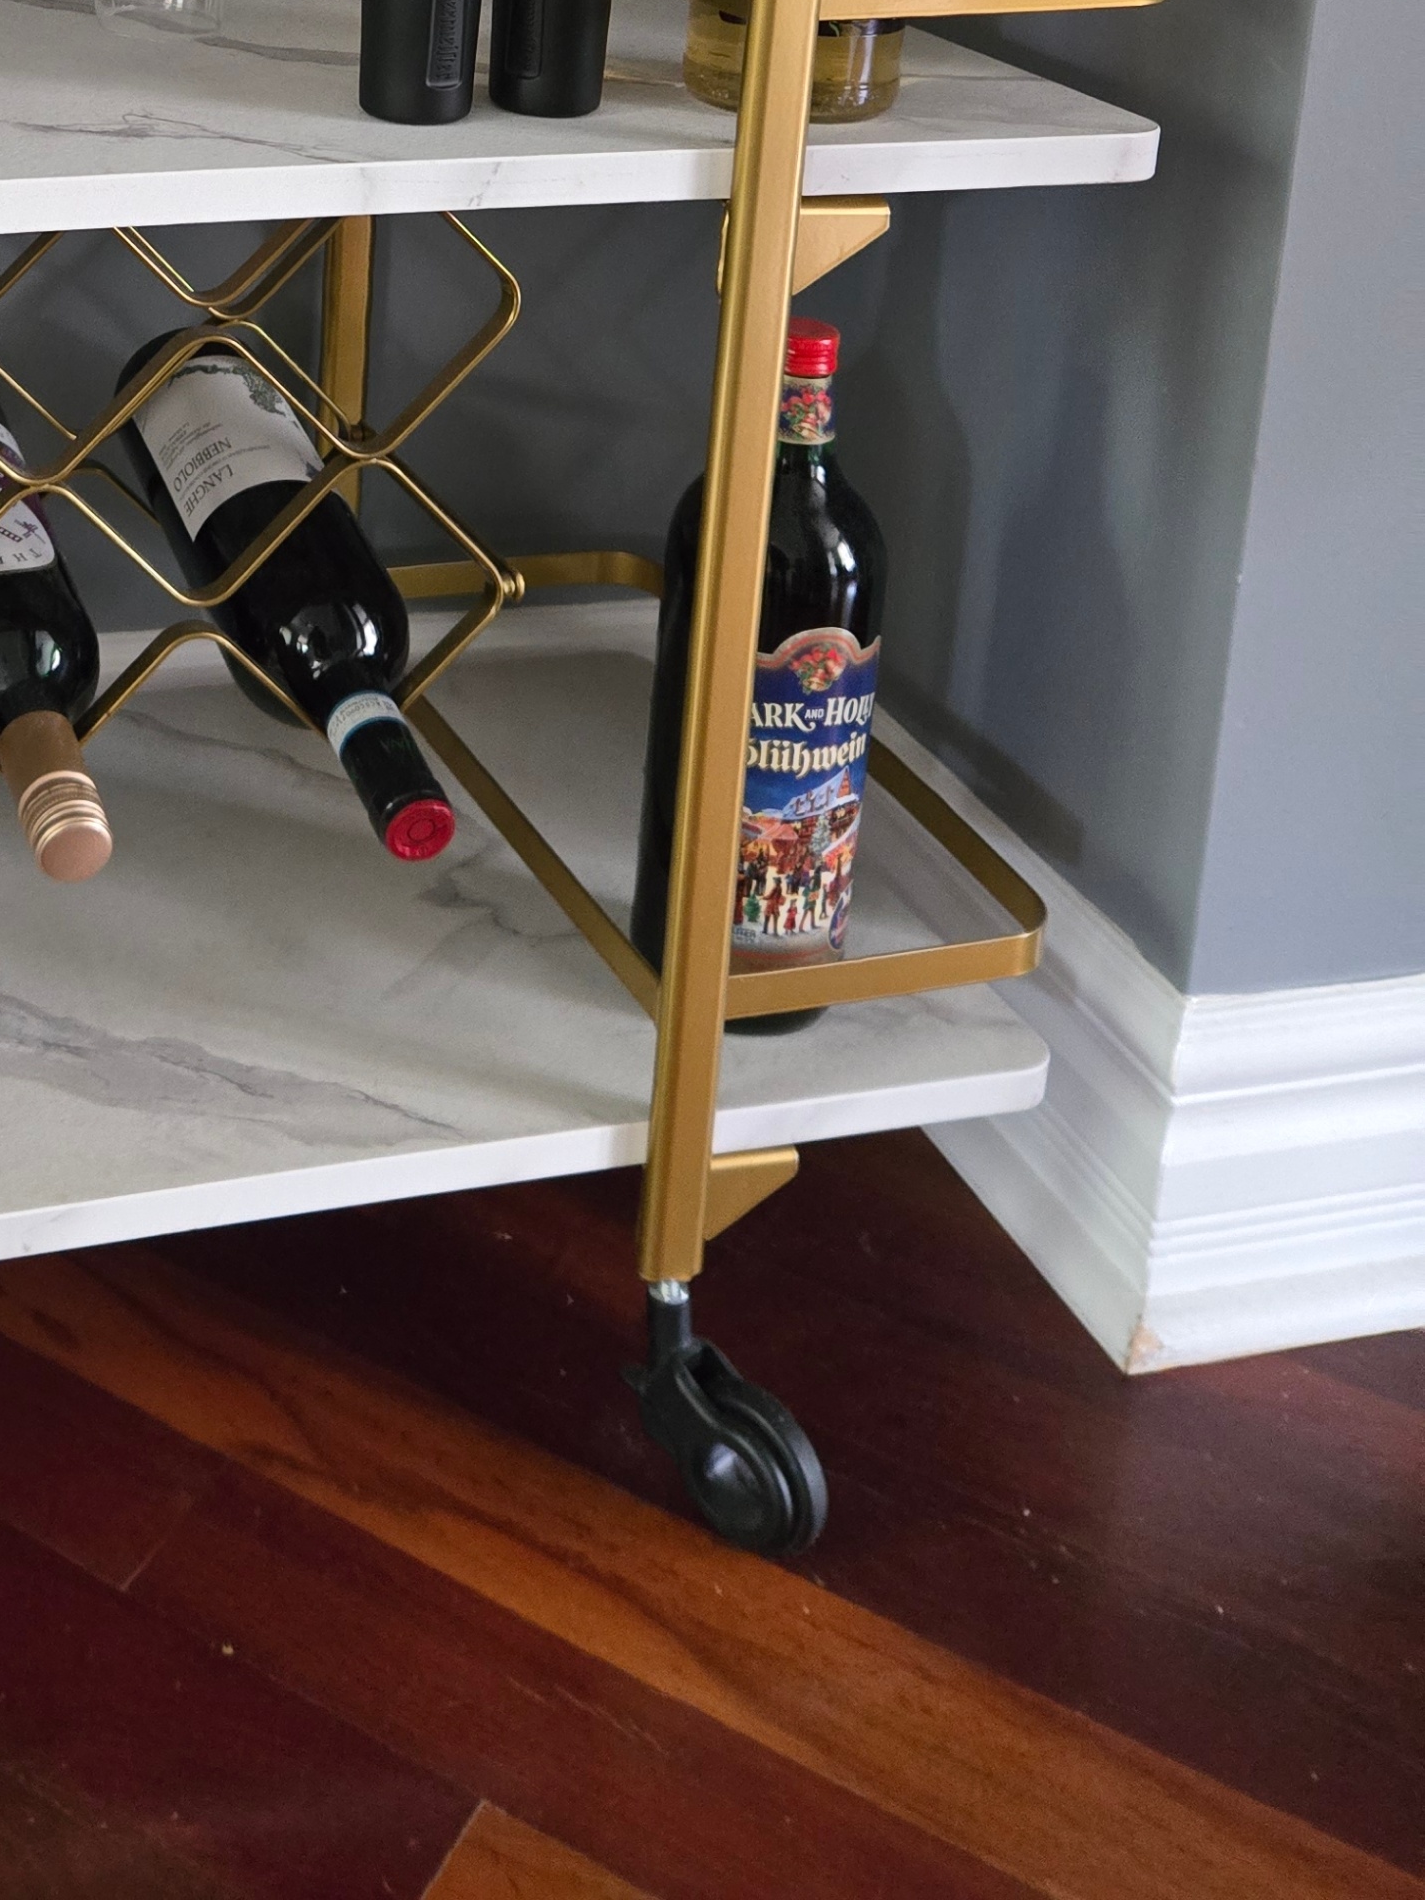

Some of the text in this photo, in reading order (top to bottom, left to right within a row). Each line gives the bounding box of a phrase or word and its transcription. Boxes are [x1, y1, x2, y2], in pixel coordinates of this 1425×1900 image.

[173, 436, 233, 493] NEBBIOLO
[184, 463, 234, 518] LANGHE
[750, 701, 817, 732] ARK
[804, 708, 825, 719] AND
